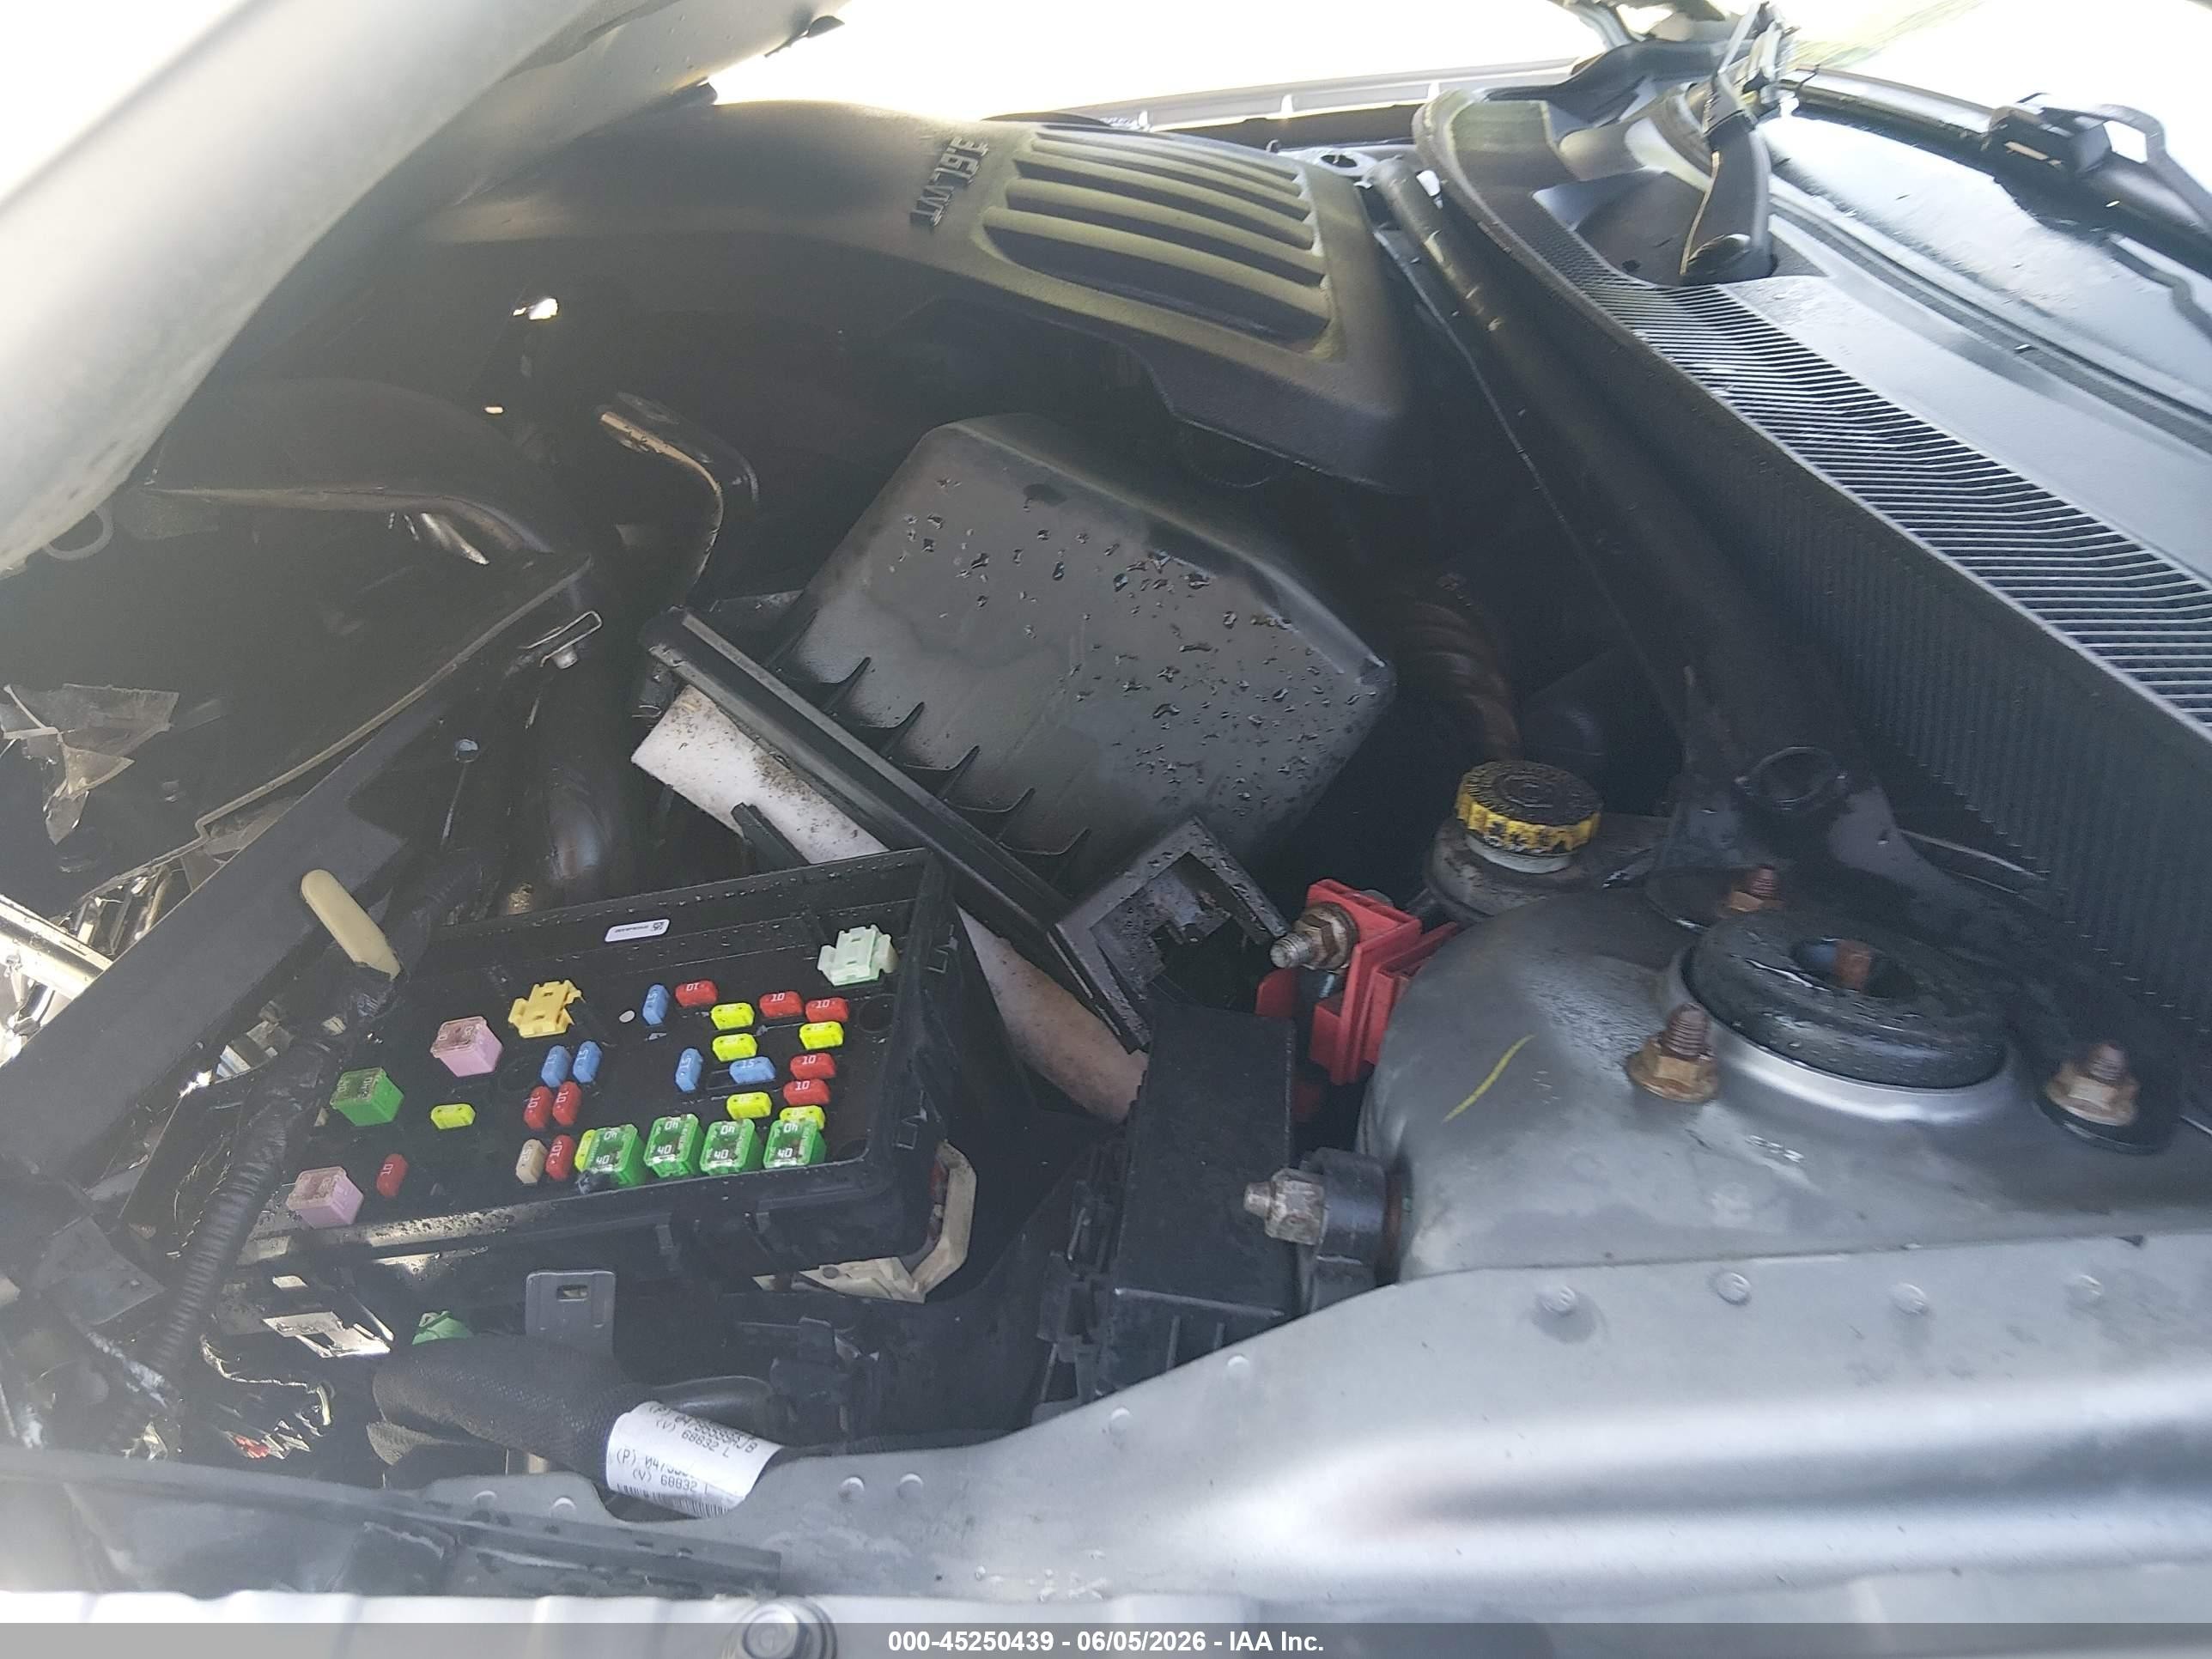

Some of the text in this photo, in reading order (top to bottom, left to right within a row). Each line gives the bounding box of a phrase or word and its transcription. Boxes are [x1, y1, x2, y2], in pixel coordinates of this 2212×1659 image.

[928, 135, 989, 186] 3.6L
[685, 981, 701, 992] 10
[770, 993, 786, 1002] 10
[816, 1000, 830, 1009] 10
[576, 1048, 589, 1061] 15
[801, 1054, 817, 1065] 10
[741, 1058, 755, 1068] 15
[795, 1080, 811, 1091] 10
[528, 1095, 541, 1108] 10
[556, 1091, 569, 1103] 10
[550, 1144, 563, 1158] 10
[657, 1144, 672, 1155] 40
[714, 1149, 729, 1159] 40
[777, 1147, 793, 1158] 40
[596, 1154, 611, 1164] 40
[381, 1164, 393, 1176] 10
[617, 1448, 637, 1466] (P)
[632, 1468, 653, 1483] (V)
[660, 1473, 698, 1493] 68832
